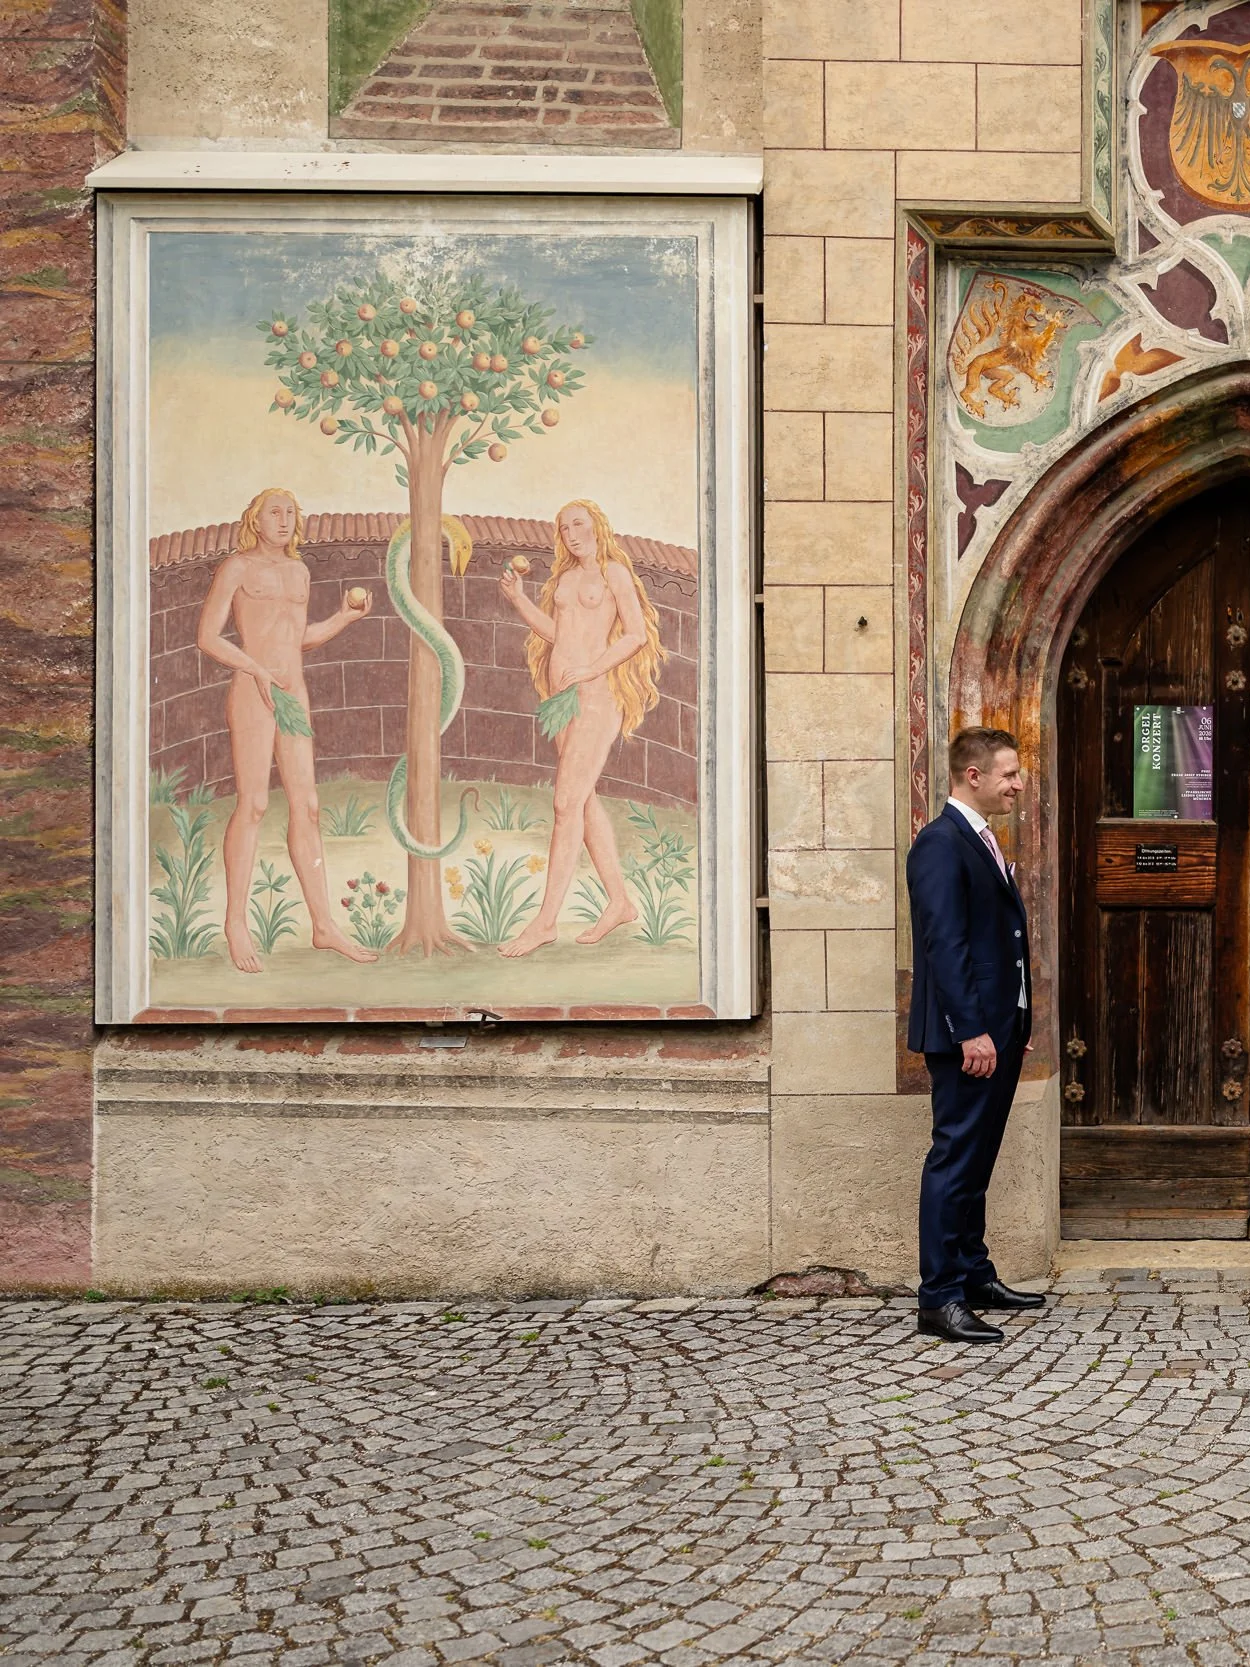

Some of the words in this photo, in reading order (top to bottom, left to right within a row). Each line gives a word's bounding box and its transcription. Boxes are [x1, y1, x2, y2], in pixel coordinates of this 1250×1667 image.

[1141, 713, 1151, 753] ORGEL
[1201, 717, 1212, 725] 06
[1152, 713, 1162, 770] KONZERT
